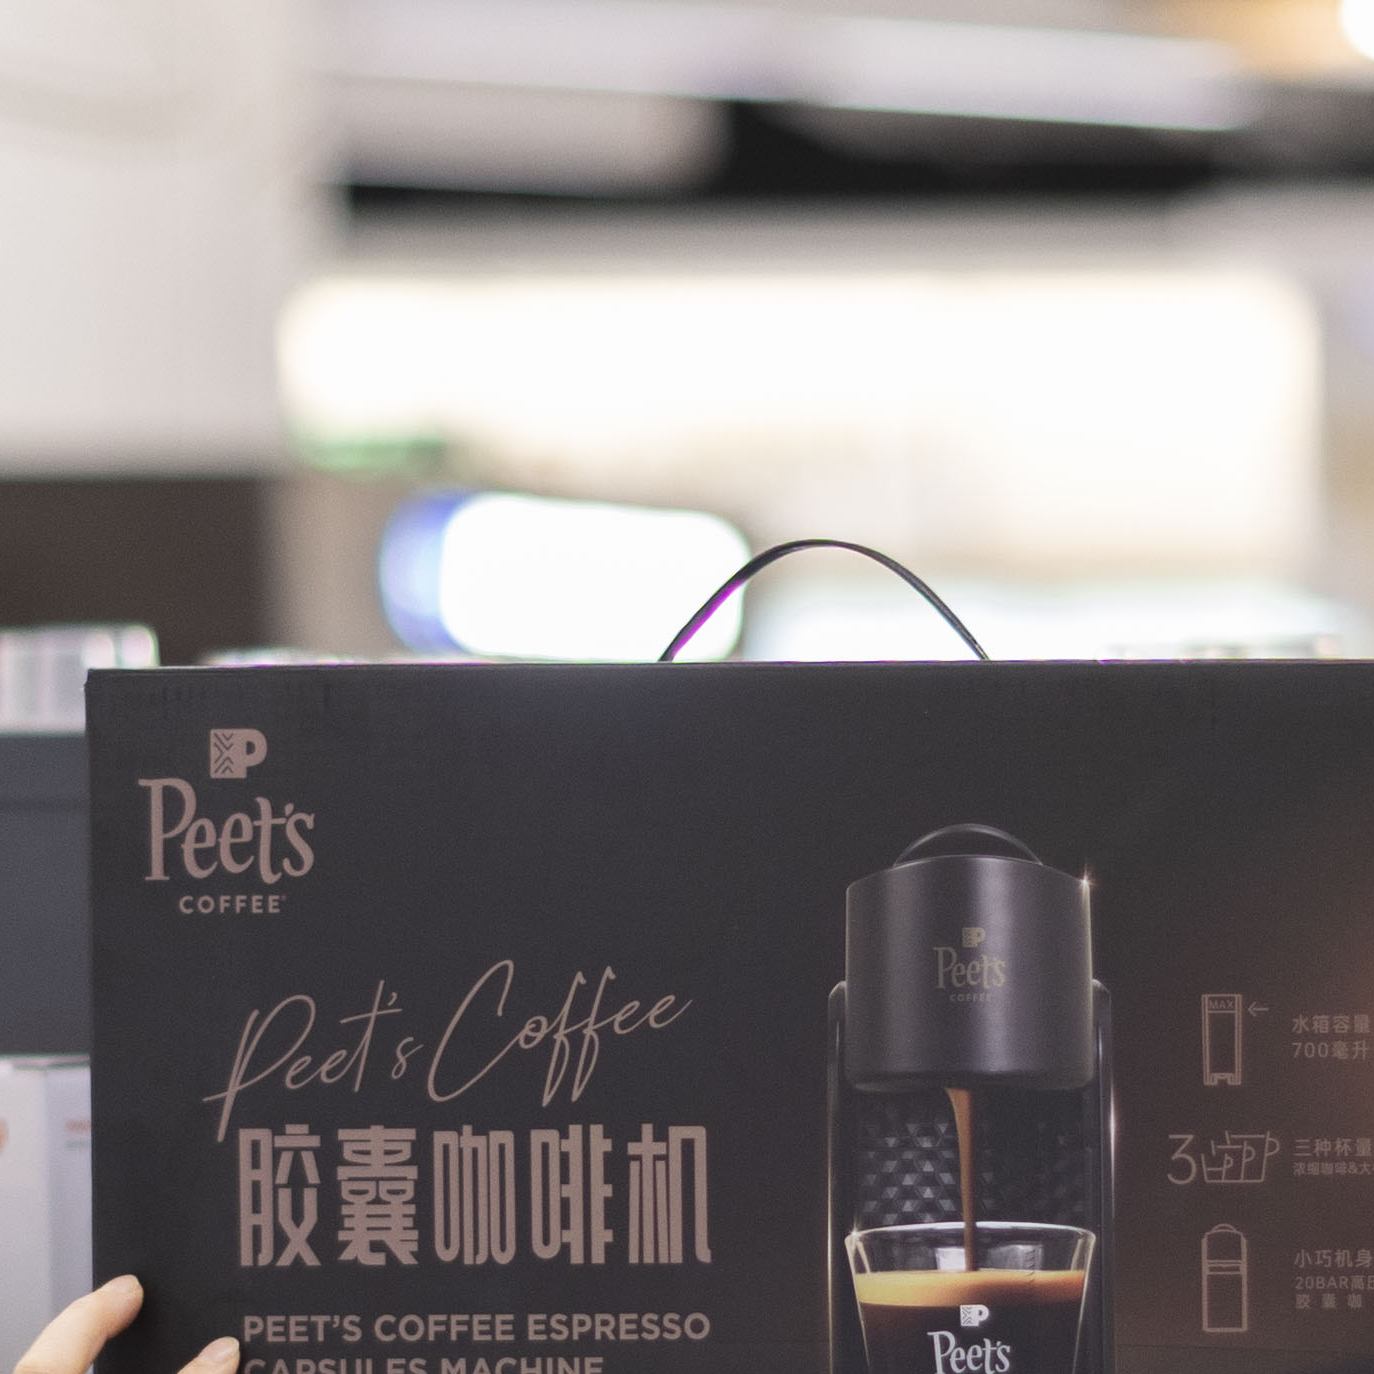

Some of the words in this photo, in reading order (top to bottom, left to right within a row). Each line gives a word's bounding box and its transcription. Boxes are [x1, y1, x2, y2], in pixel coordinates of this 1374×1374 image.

[138, 777, 316, 884] Peet's
[933, 946, 1008, 989] Peet's
[1209, 999, 1235, 1010] MAX
[1291, 1014, 1371, 1034] 水箱容量
[202, 979, 424, 1143] Peet's
[427, 960, 693, 1108] Coffee
[1291, 1040, 1369, 1060] 700毫升
[238, 1123, 712, 1267] 胶囊咖啡机
[244, 1314, 363, 1342] PEET'S
[374, 1313, 515, 1342] COFFEE
[527, 1312, 711, 1341] ESPRESSO
